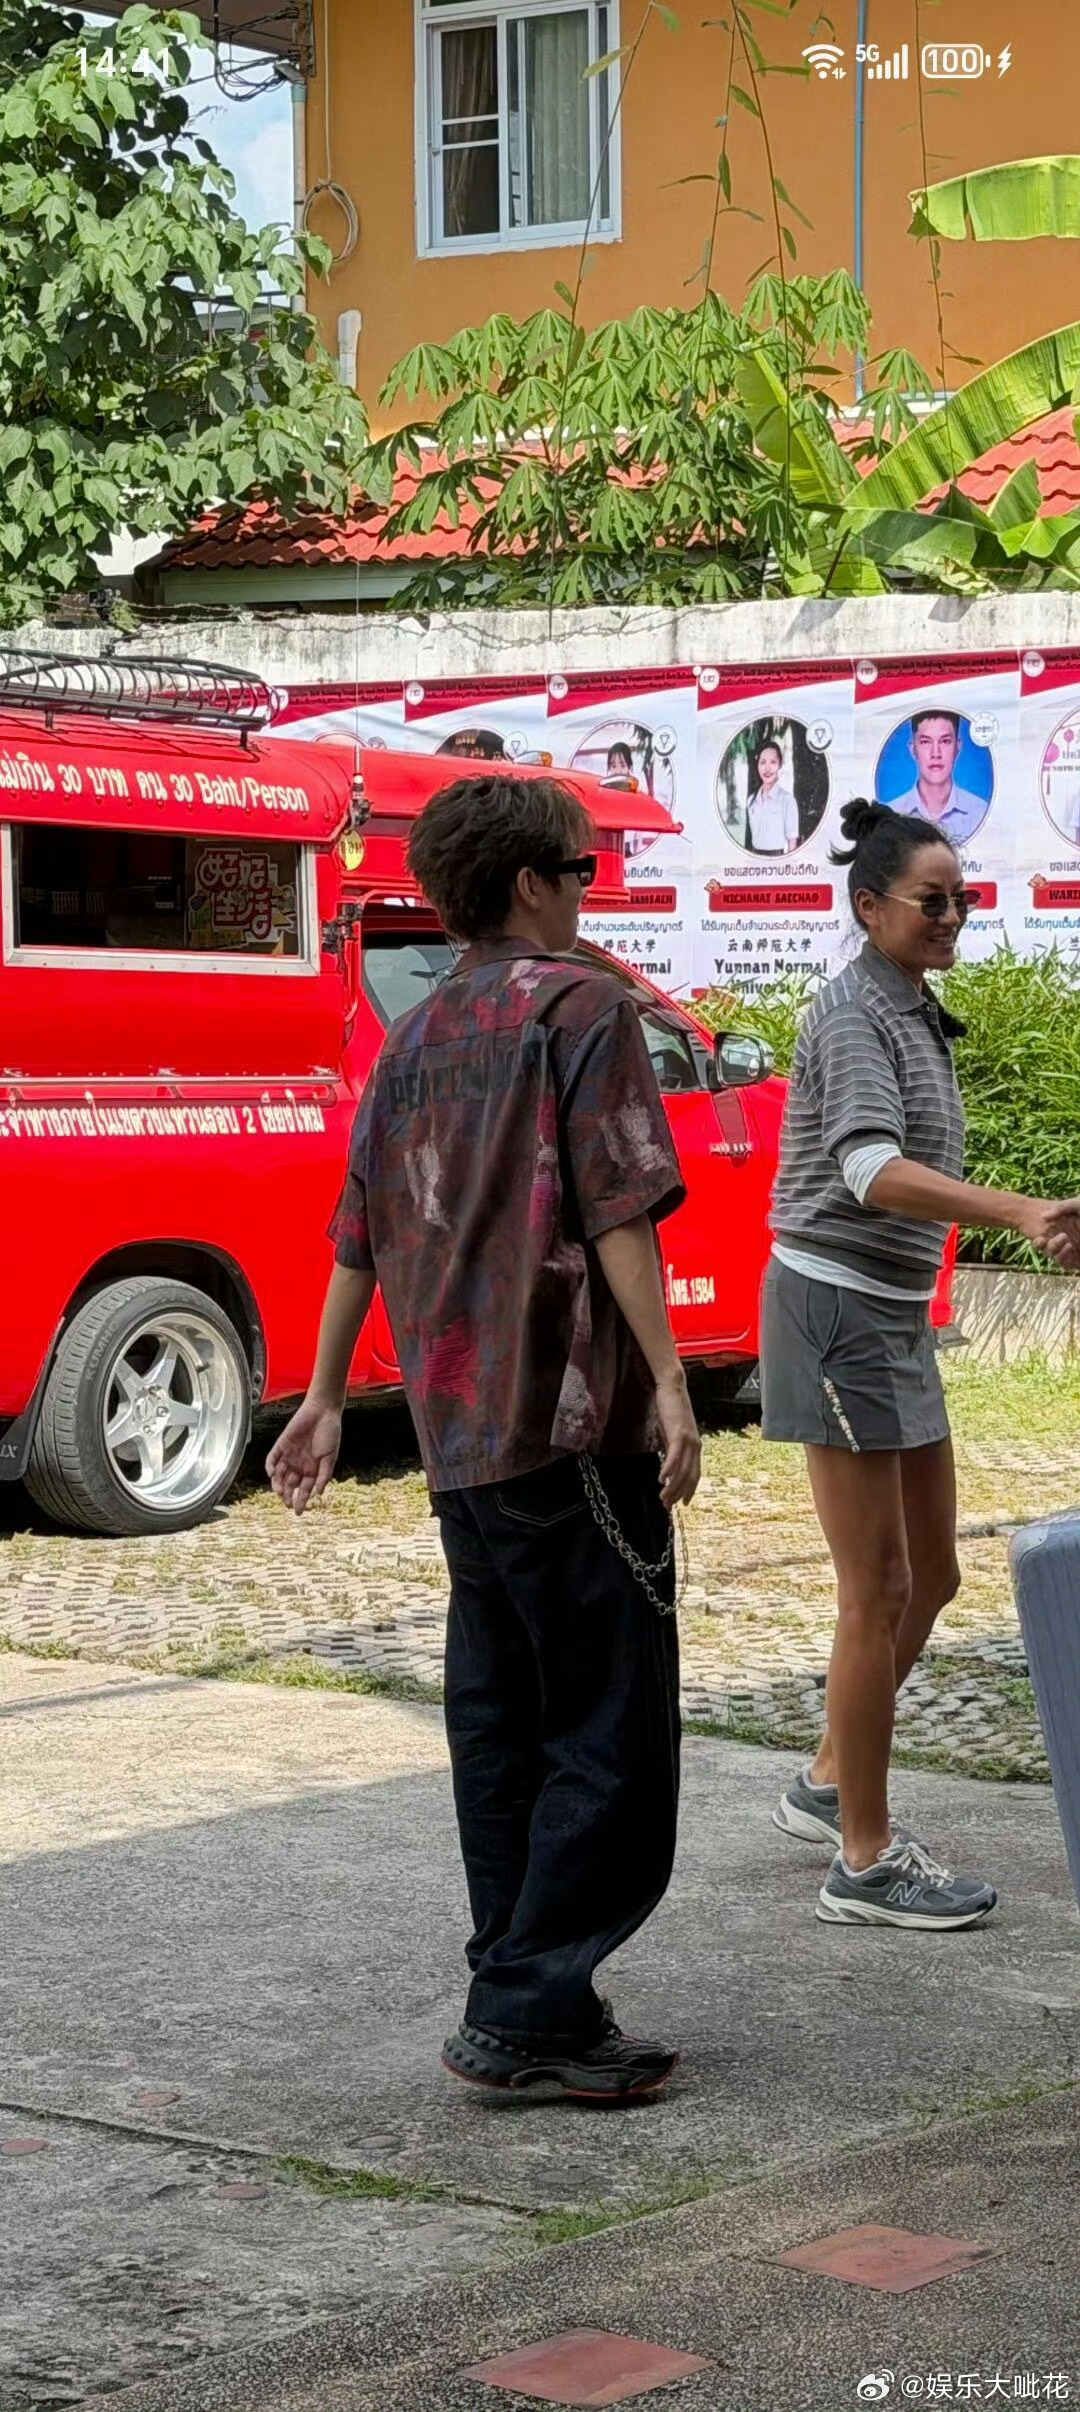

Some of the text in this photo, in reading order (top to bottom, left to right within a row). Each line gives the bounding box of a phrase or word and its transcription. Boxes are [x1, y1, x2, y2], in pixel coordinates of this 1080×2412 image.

[57, 763, 82, 794] 30
[86, 766, 129, 797] บาท
[169, 774, 194, 803] 30
[194, 772, 310, 813] Baht/Person
[724, 864, 818, 877] ขอแสดงความยินดีกับ
[1049, 889, 1080, 901] WARI
[714, 958, 770, 974] Yunnan
[241, 1105, 257, 1134] 2
[257, 1088, 325, 1134] เชียงใหม่
[886, 1881, 921, 1906] N
